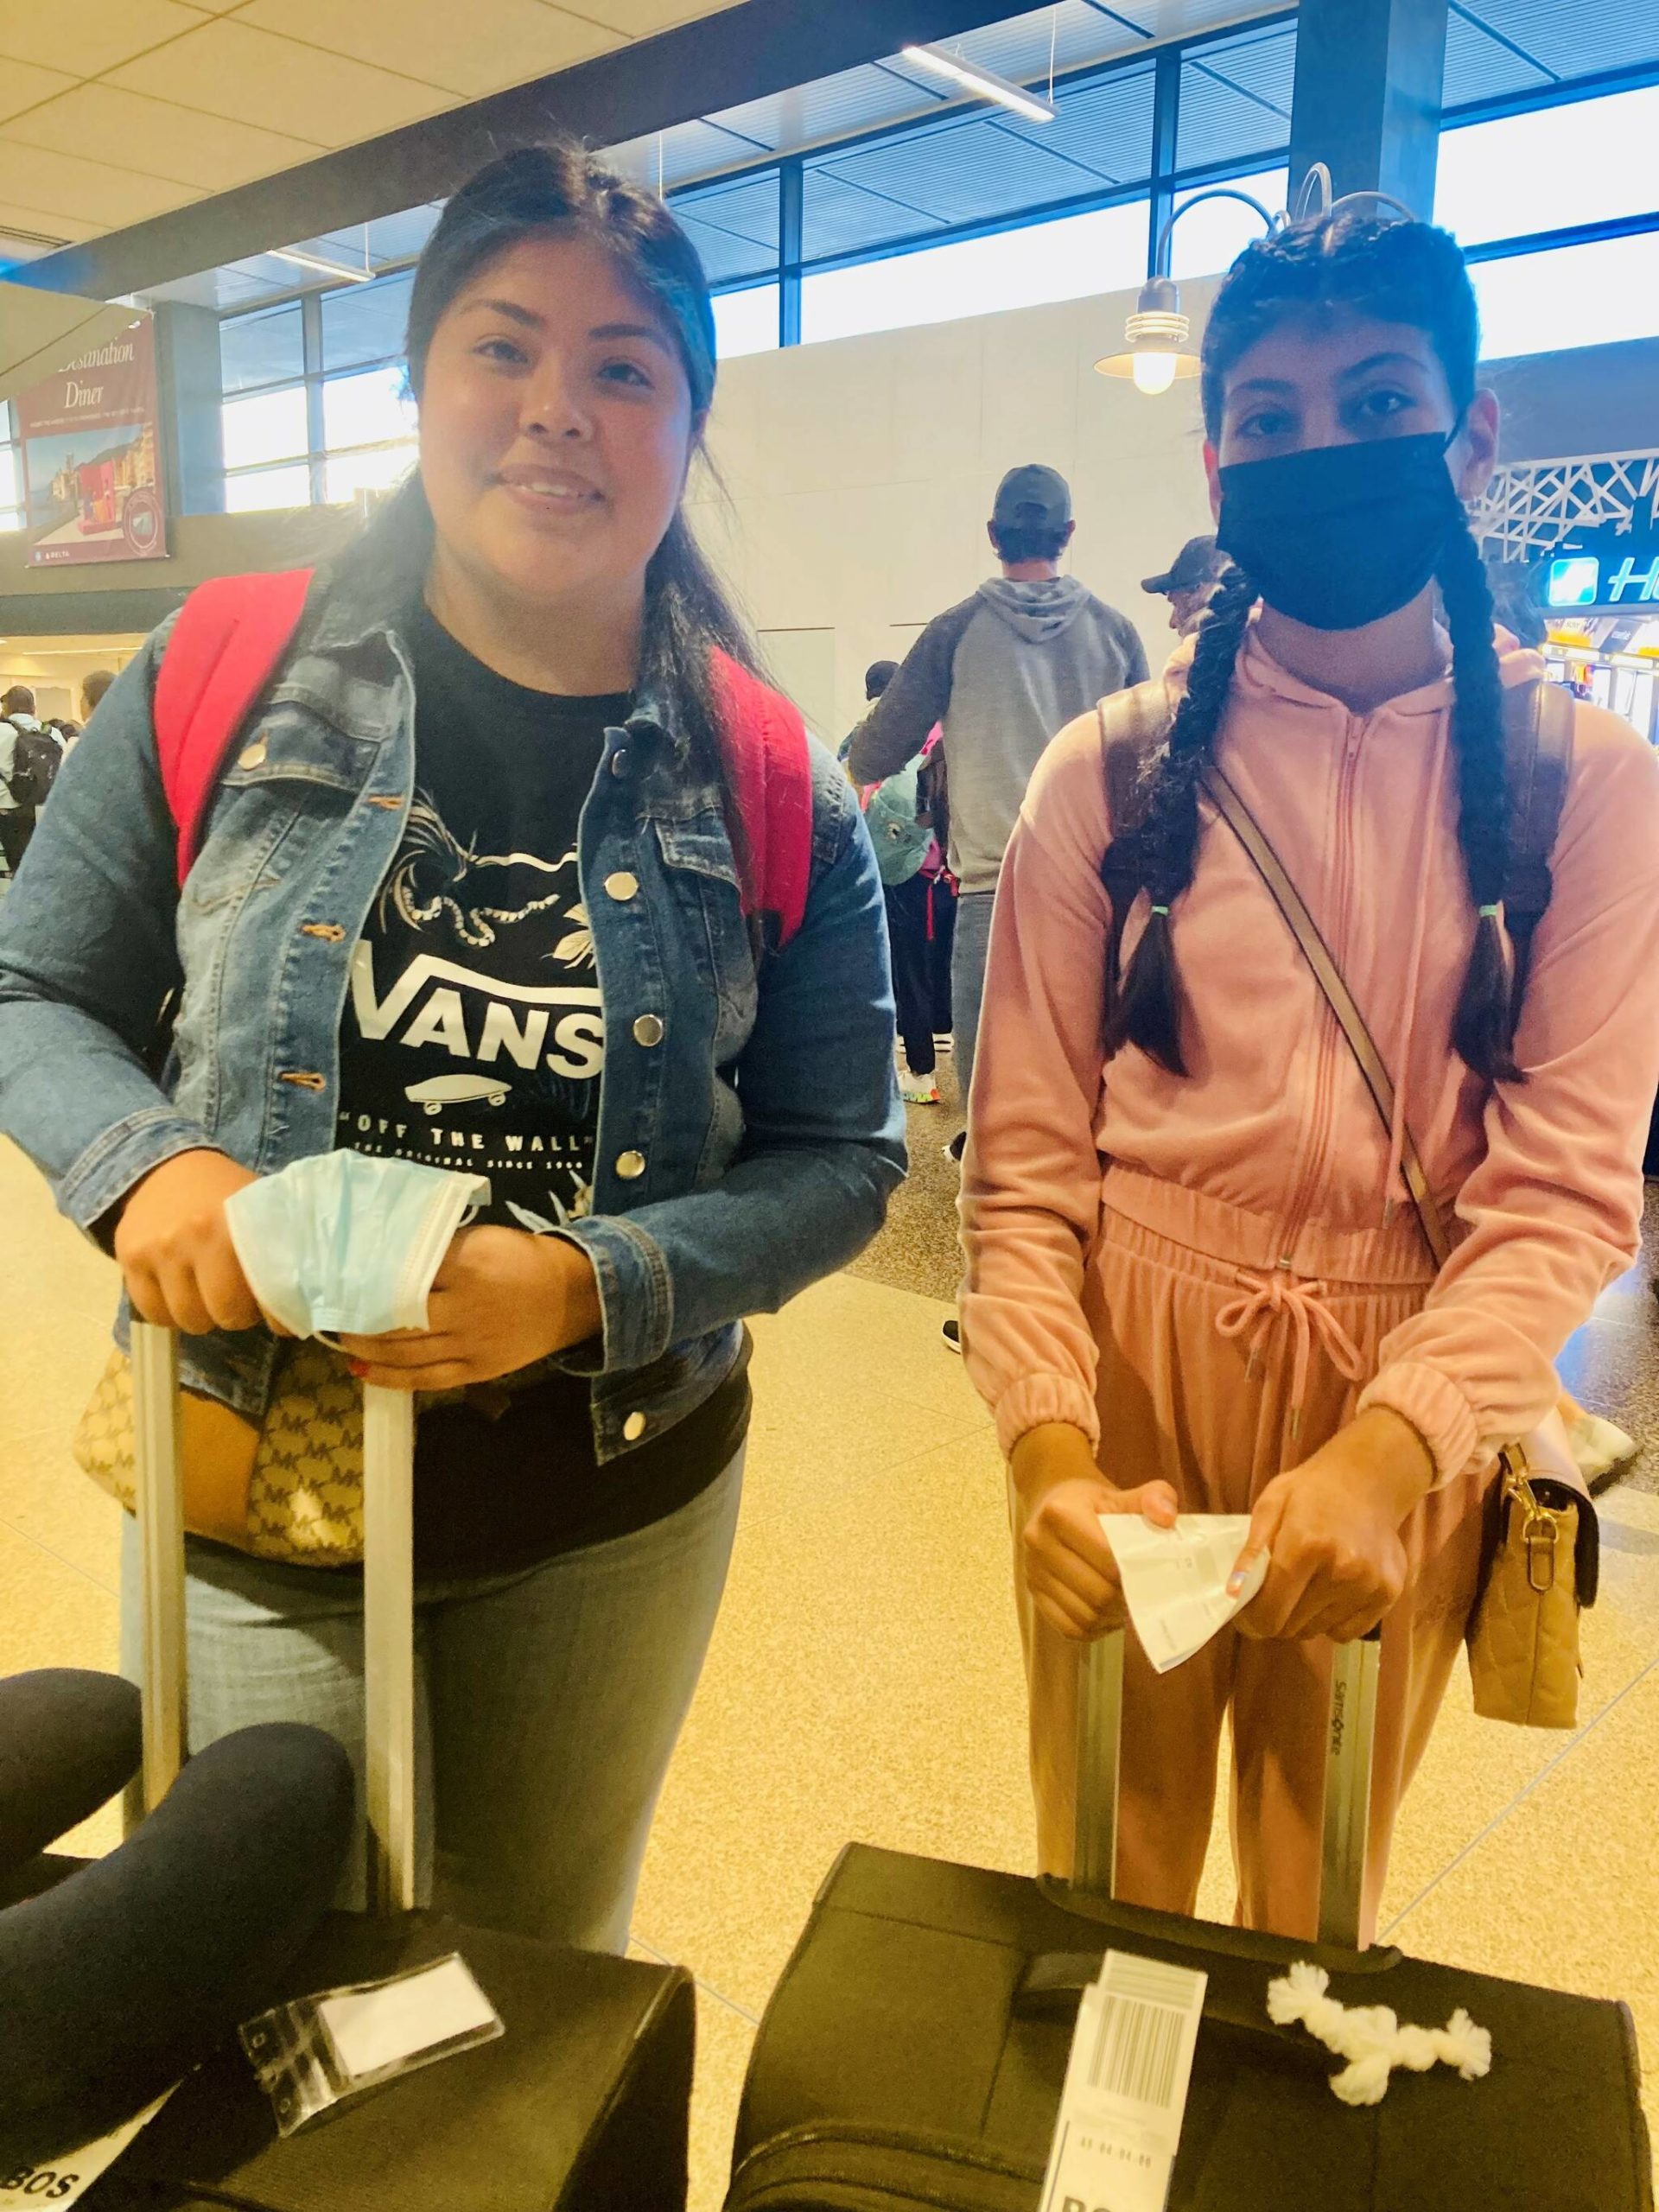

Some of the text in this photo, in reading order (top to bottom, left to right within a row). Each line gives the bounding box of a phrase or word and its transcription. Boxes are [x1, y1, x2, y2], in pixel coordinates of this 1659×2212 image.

[63, 379, 104, 408] Diner
[1608, 556, 1659, 602] H
[351, 940, 605, 1079] VANS
[430, 1128, 485, 1151] THE
[395, 1147, 474, 1167] ORIGINAL
[486, 1159, 533, 1170] SINCE
[0, 2166, 79, 2199] BOS
